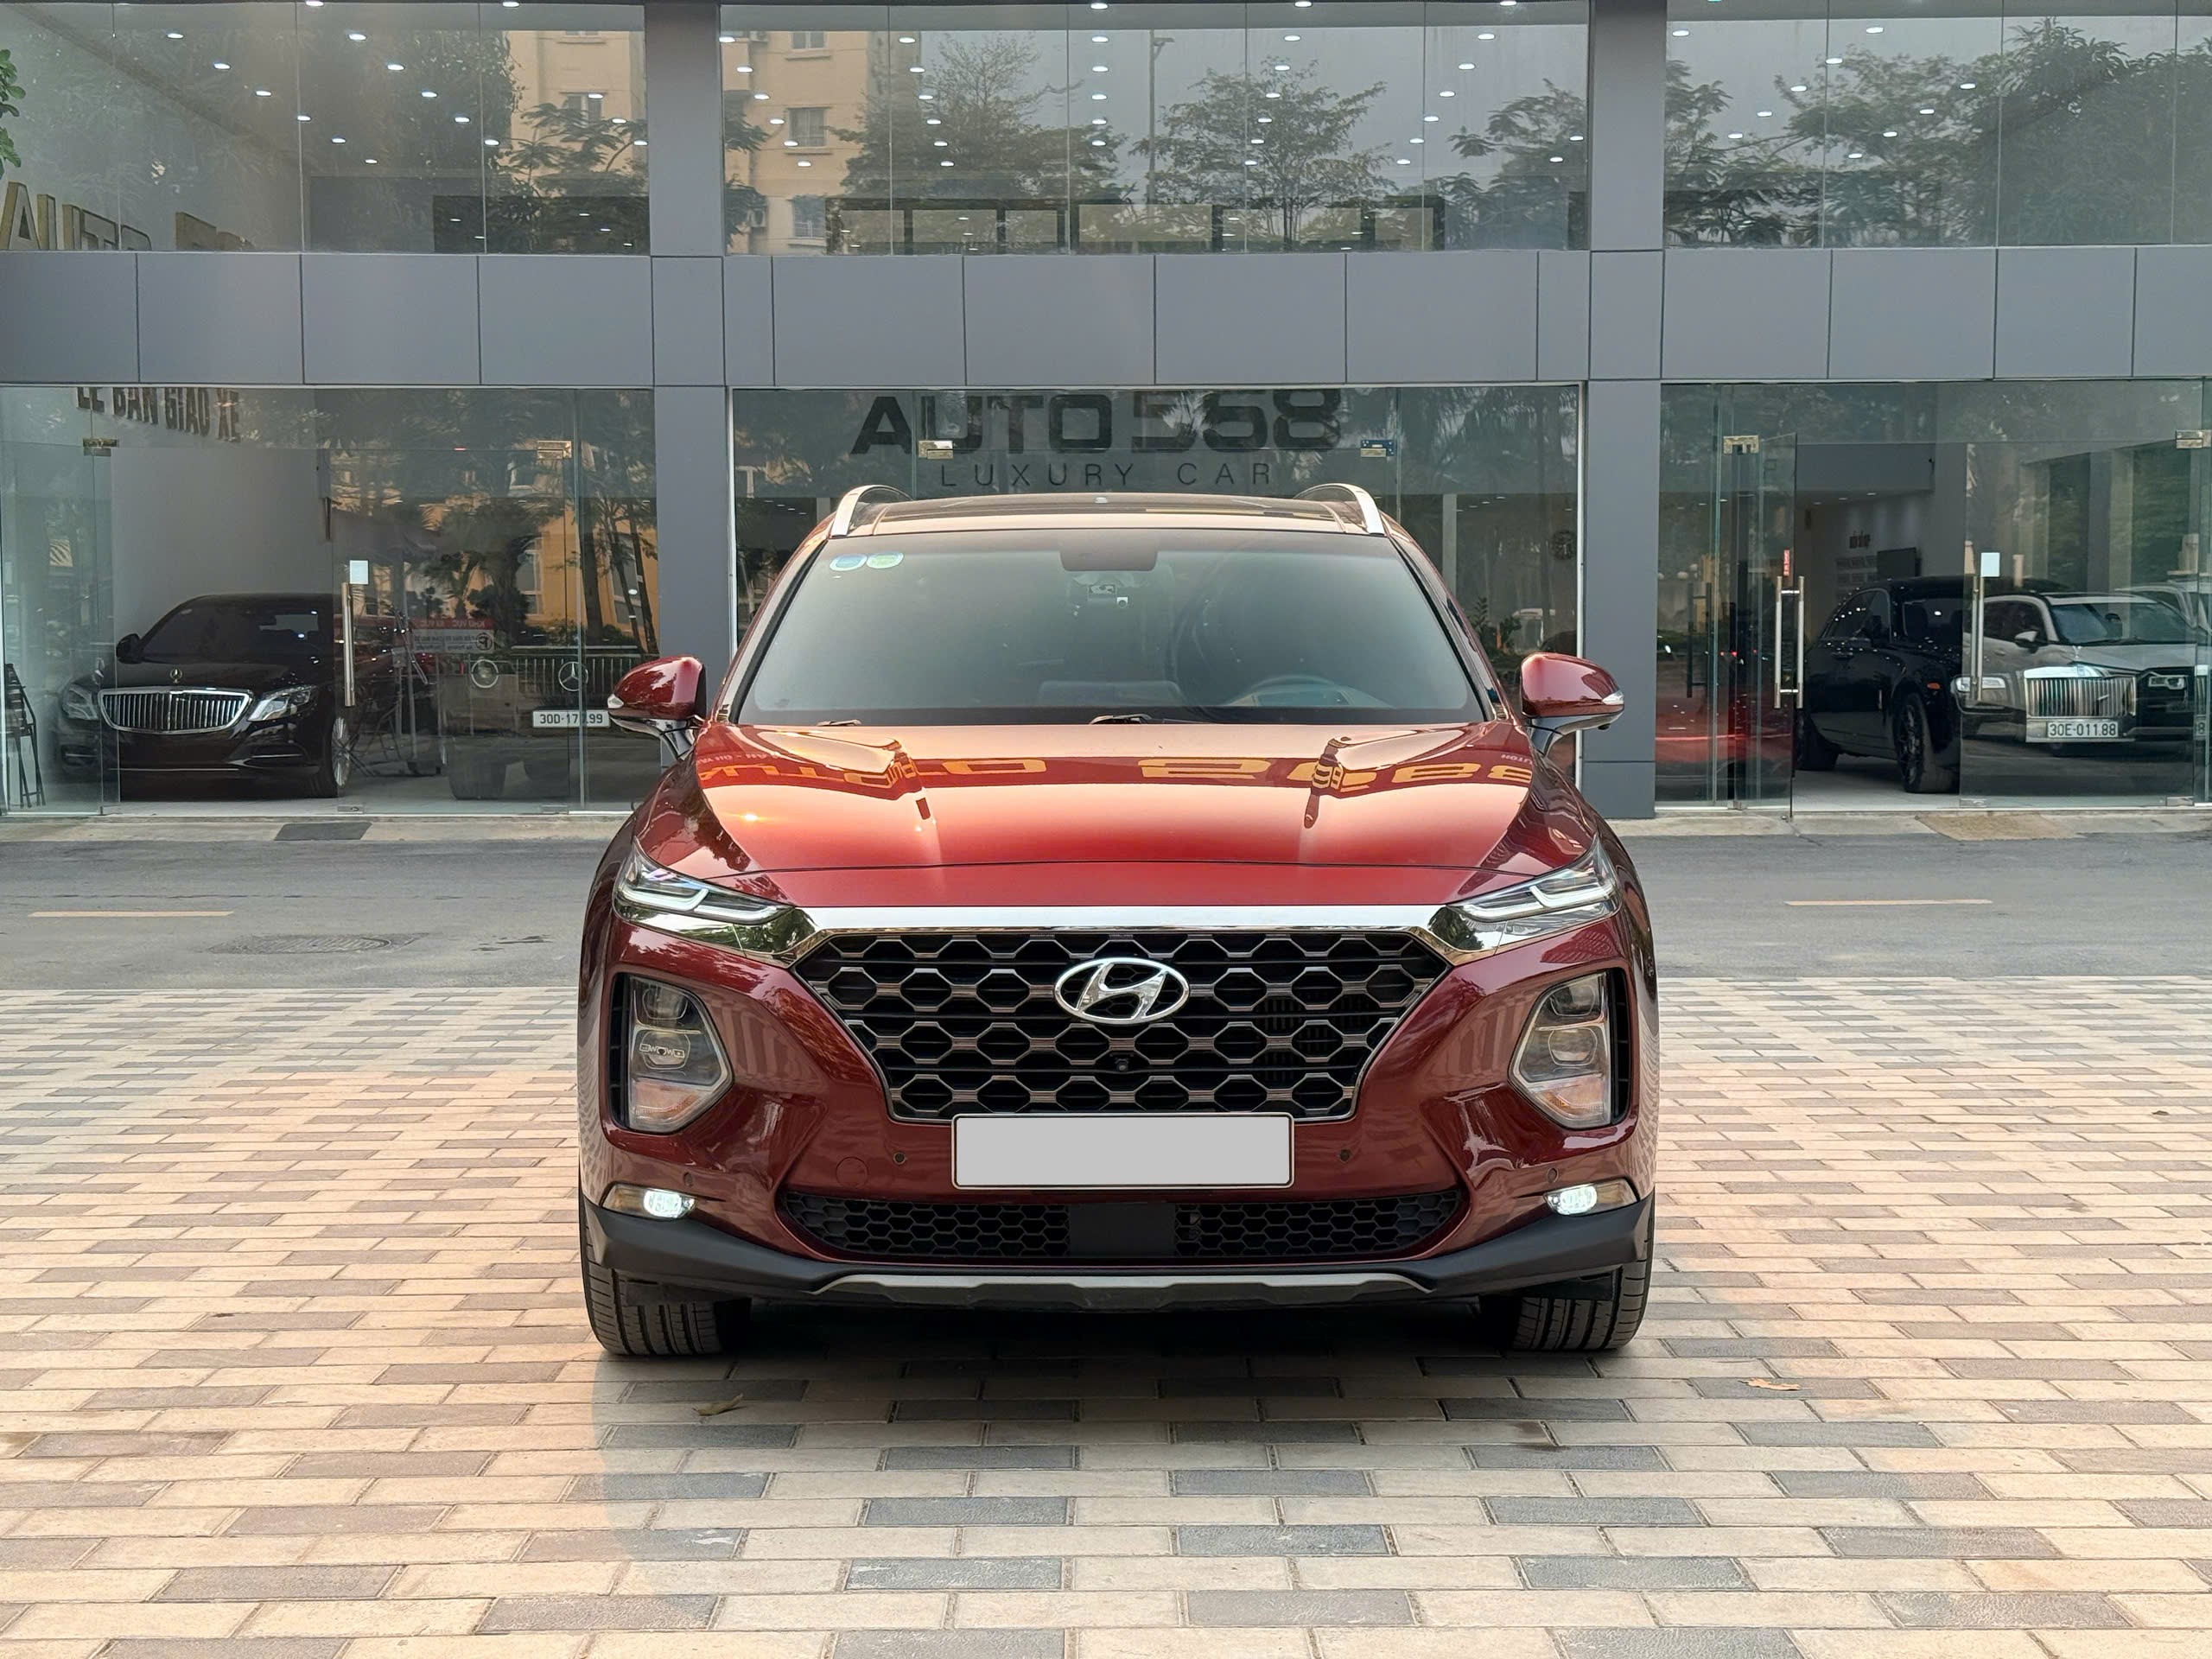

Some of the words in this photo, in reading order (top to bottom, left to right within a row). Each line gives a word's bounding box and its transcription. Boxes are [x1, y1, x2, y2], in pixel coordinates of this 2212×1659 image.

[849, 394, 1113, 454] AUTO
[1131, 389, 1342, 454] 568
[940, 463, 1134, 486] LUXURY
[1177, 463, 1270, 486] CAR
[2049, 723, 2117, 736] 30E-011.88
